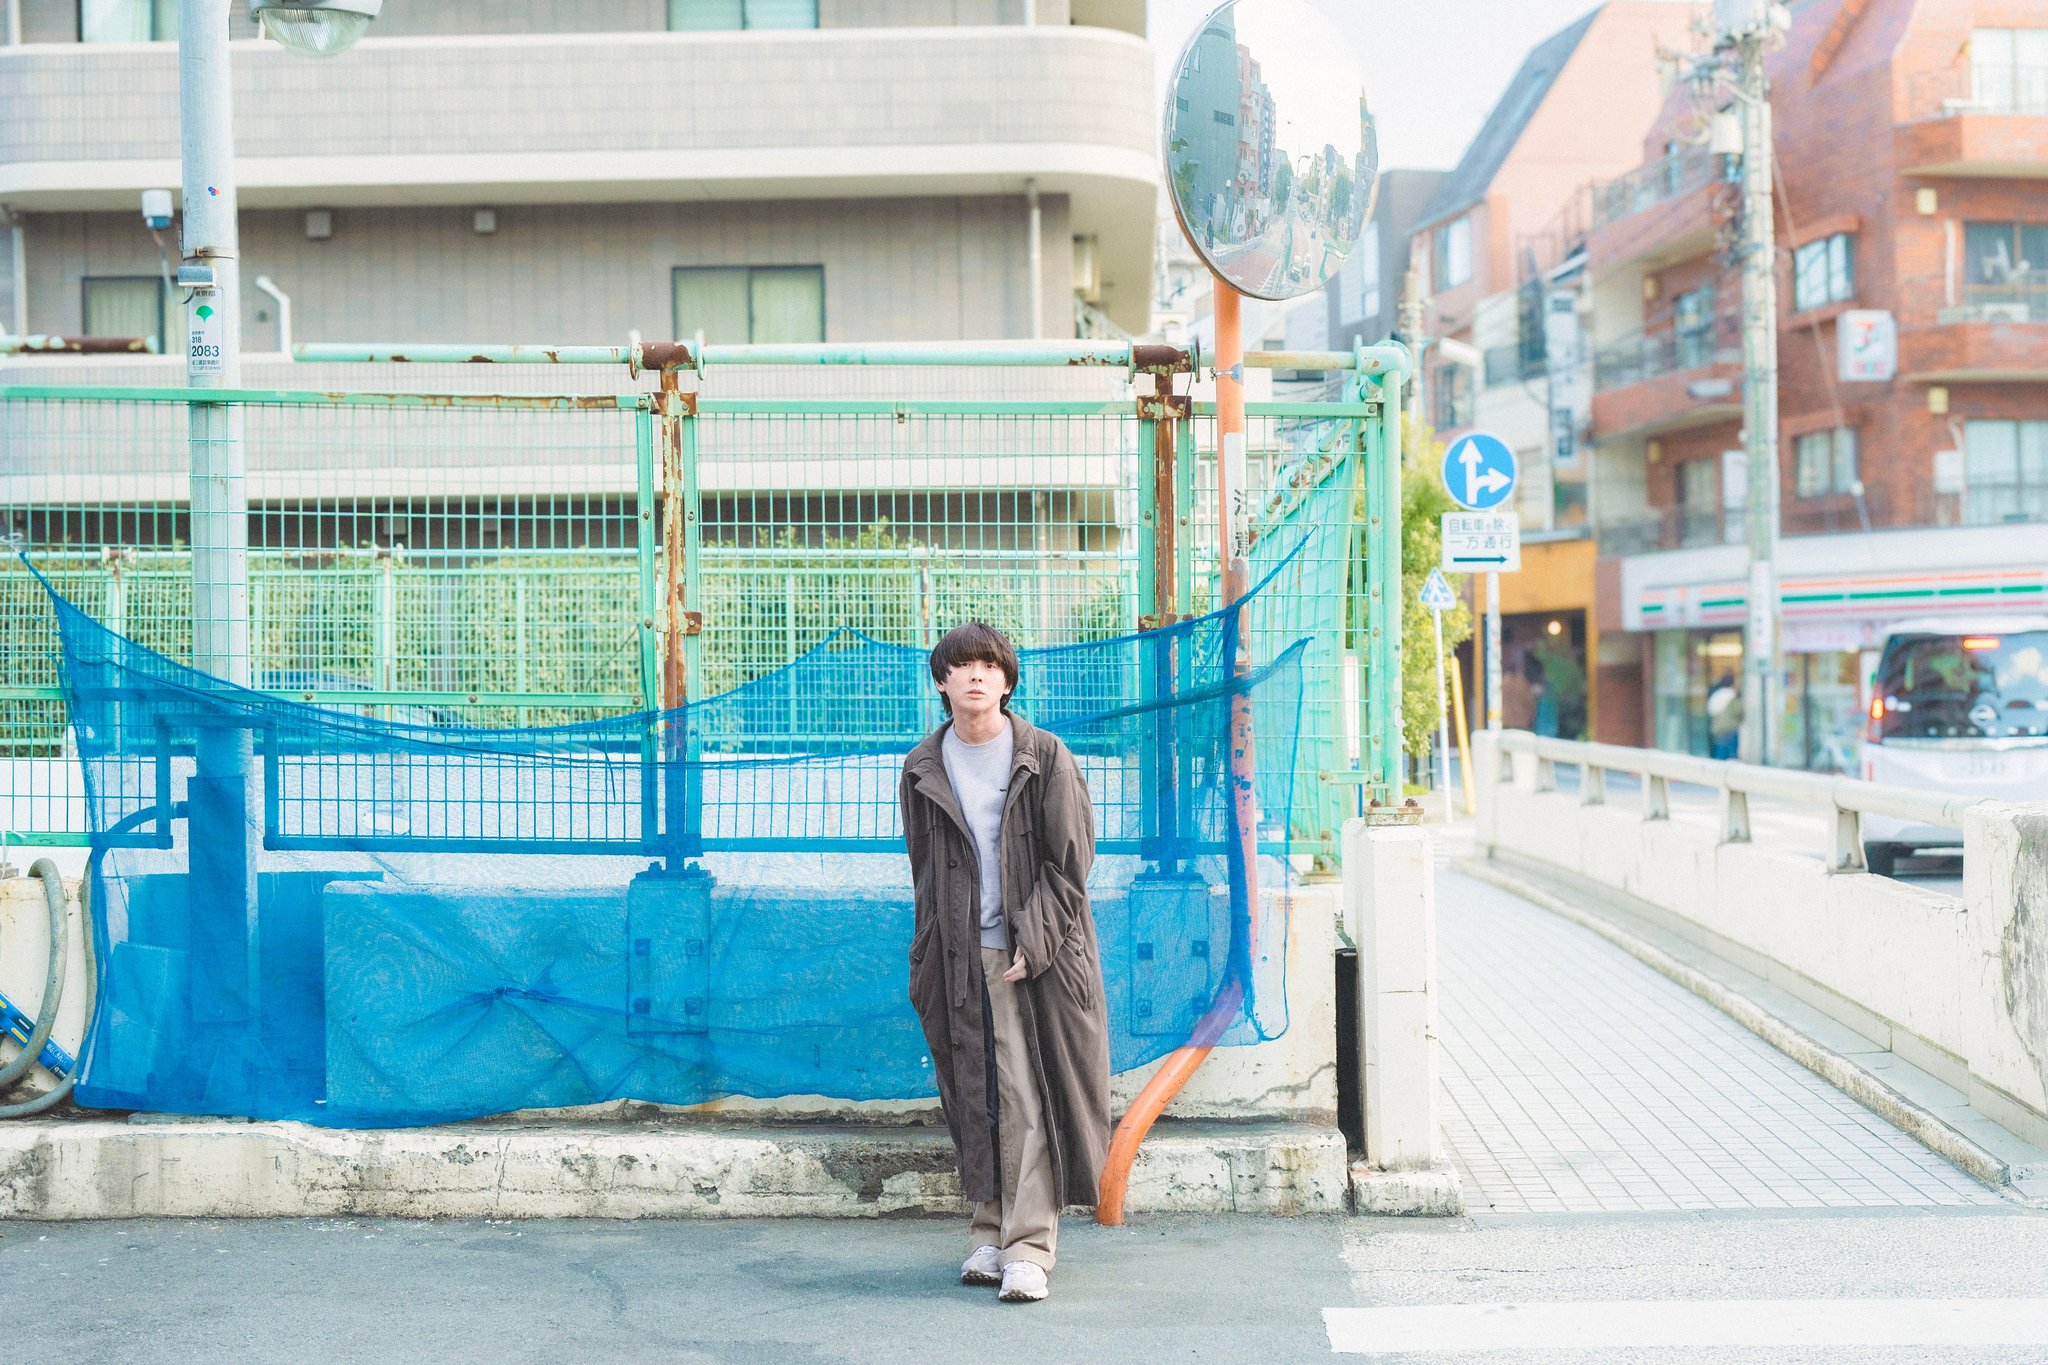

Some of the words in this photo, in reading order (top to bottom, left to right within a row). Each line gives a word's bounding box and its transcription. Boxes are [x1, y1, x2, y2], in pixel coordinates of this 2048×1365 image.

[192, 345, 219, 357] 2083
[1449, 518, 1512, 532] 自転車を除く
[1449, 535, 1512, 549] 一方通行
